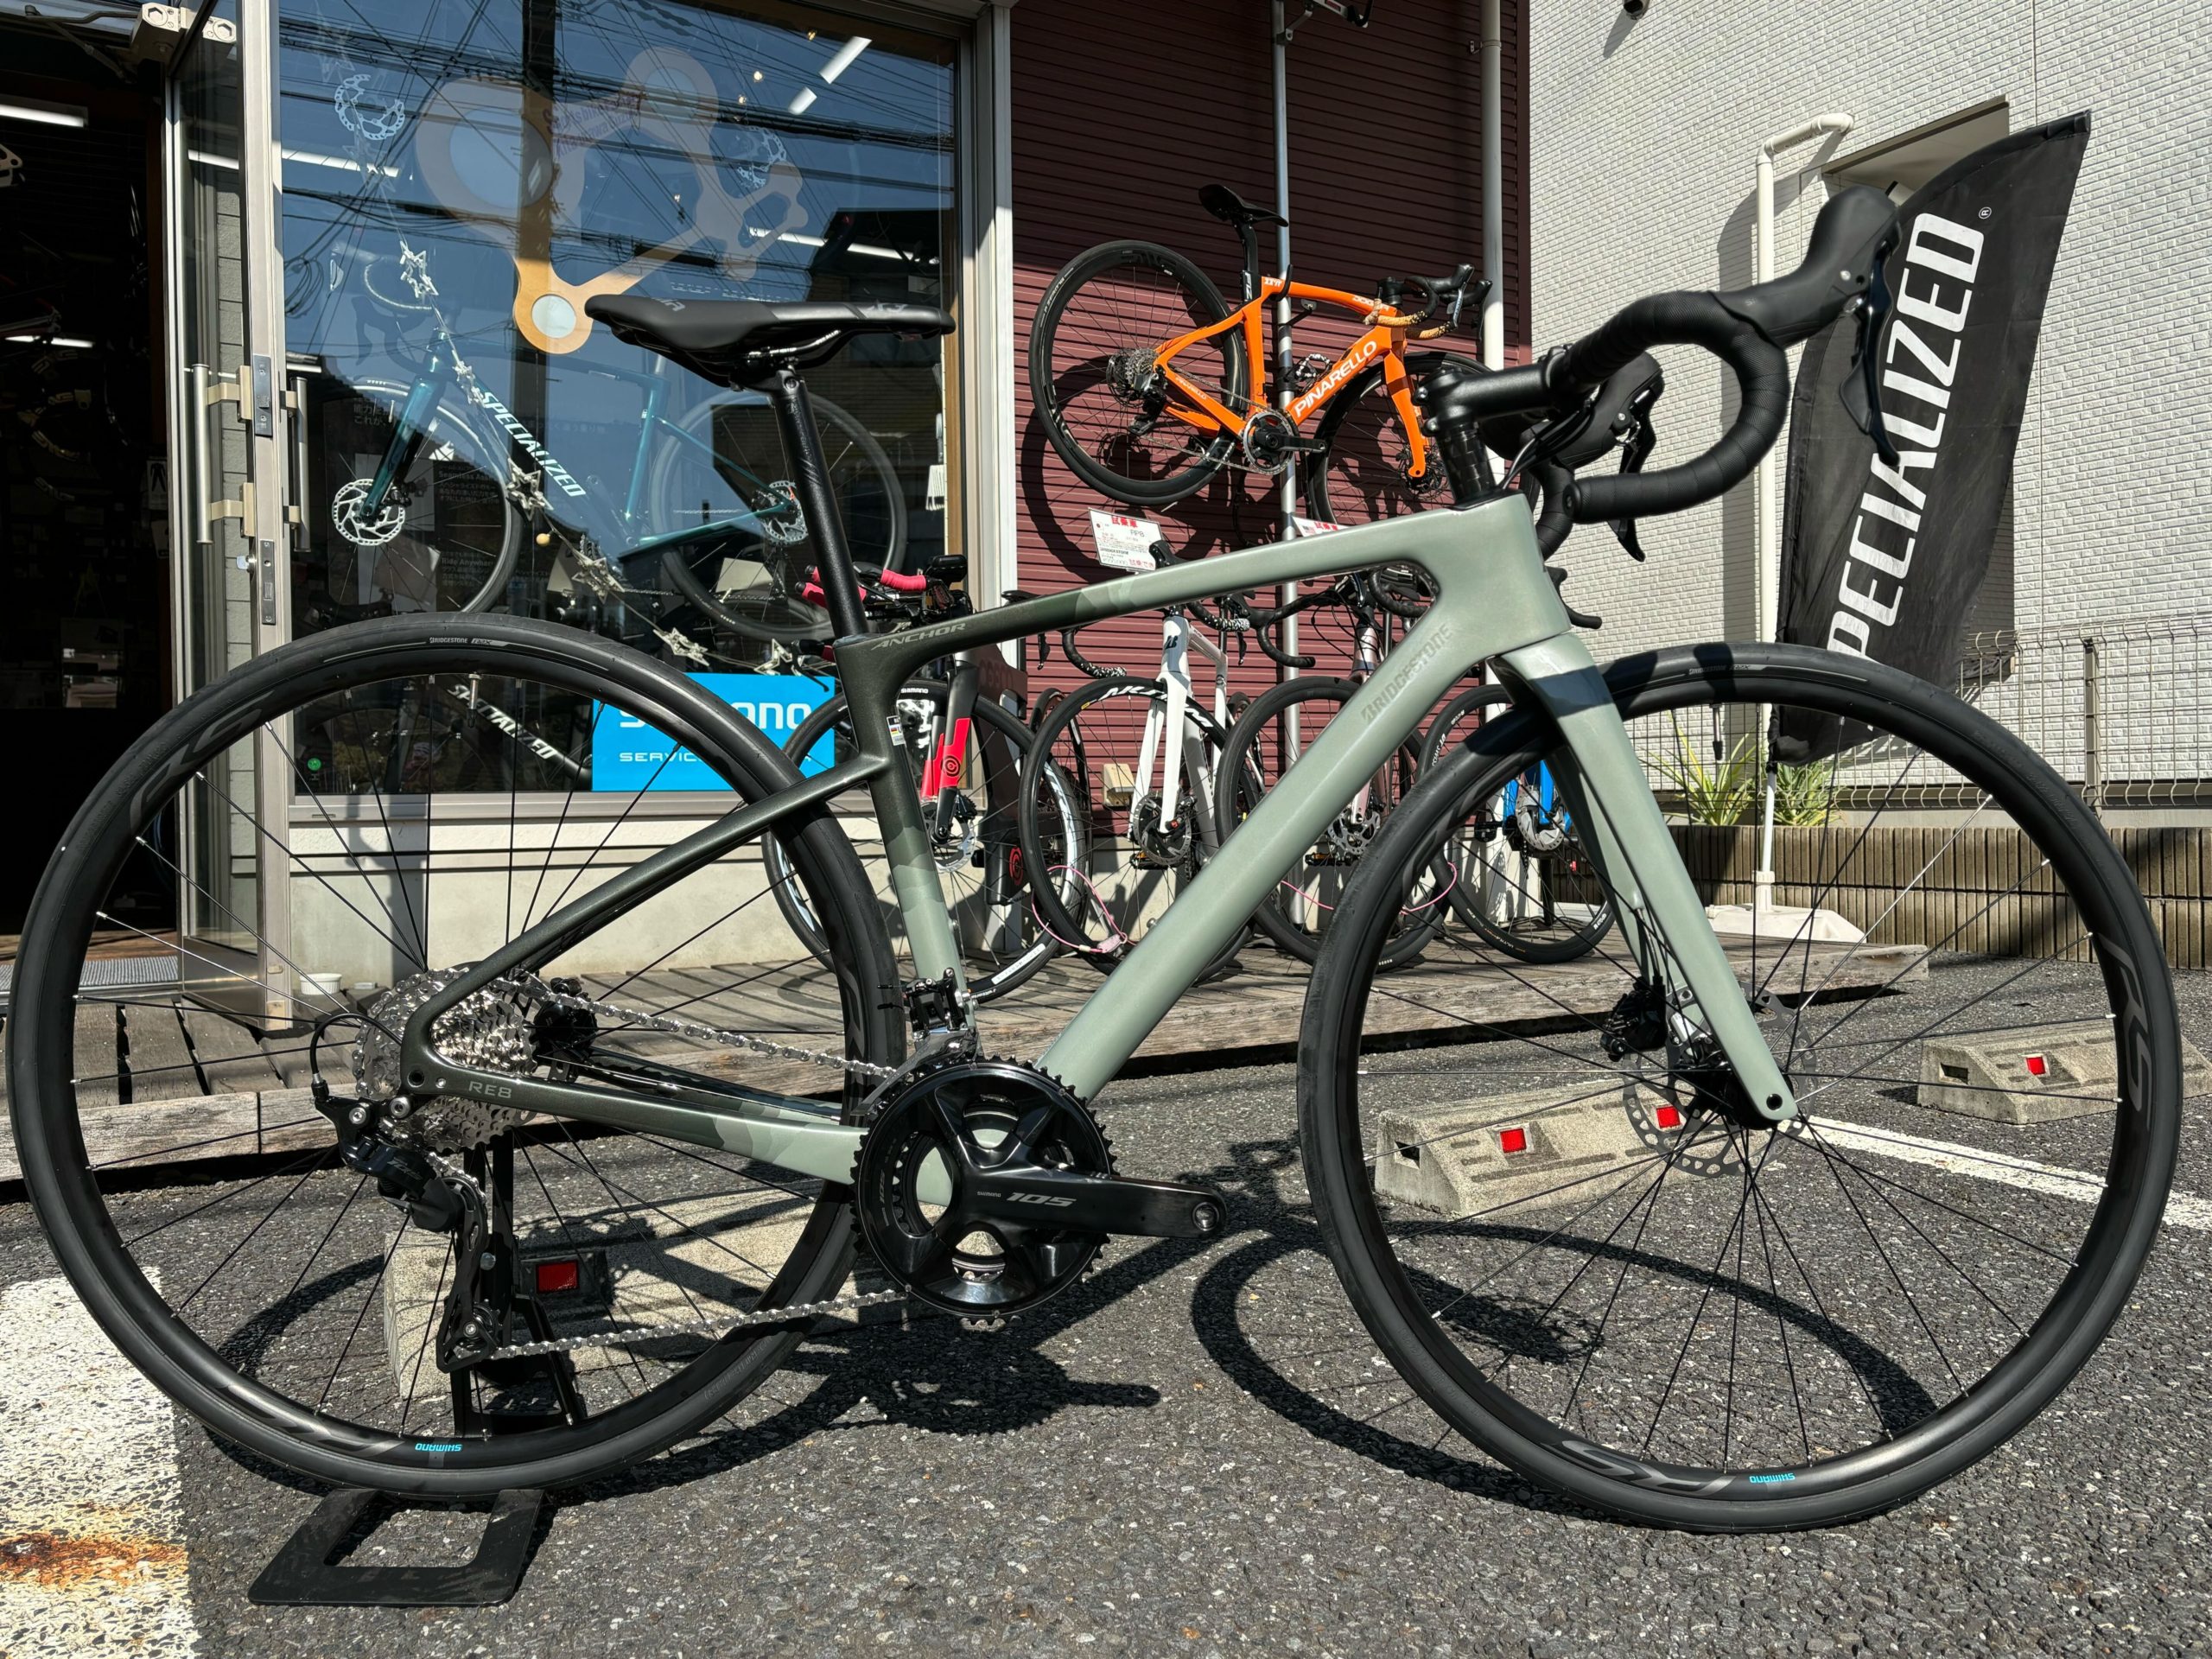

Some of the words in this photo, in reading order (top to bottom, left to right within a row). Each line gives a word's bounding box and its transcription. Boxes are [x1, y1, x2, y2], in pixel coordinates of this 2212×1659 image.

[1294, 340, 1377, 418] PINARELLO
[482, 391, 587, 498] SPECIALIZED
[1826, 213, 1985, 664] PECIALIZED
[871, 622, 967, 651] ANCHOR
[1361, 623, 1452, 723] BRIDGESTONE
[447, 683, 558, 760] SPCIALIZED
[619, 752, 703, 763] SERVIC
[468, 1081, 512, 1099] RE8
[1007, 1192, 1077, 1207] 105
[415, 1442, 463, 1452] SHIMANO
[1749, 1472, 1796, 1484] SHIMANO
